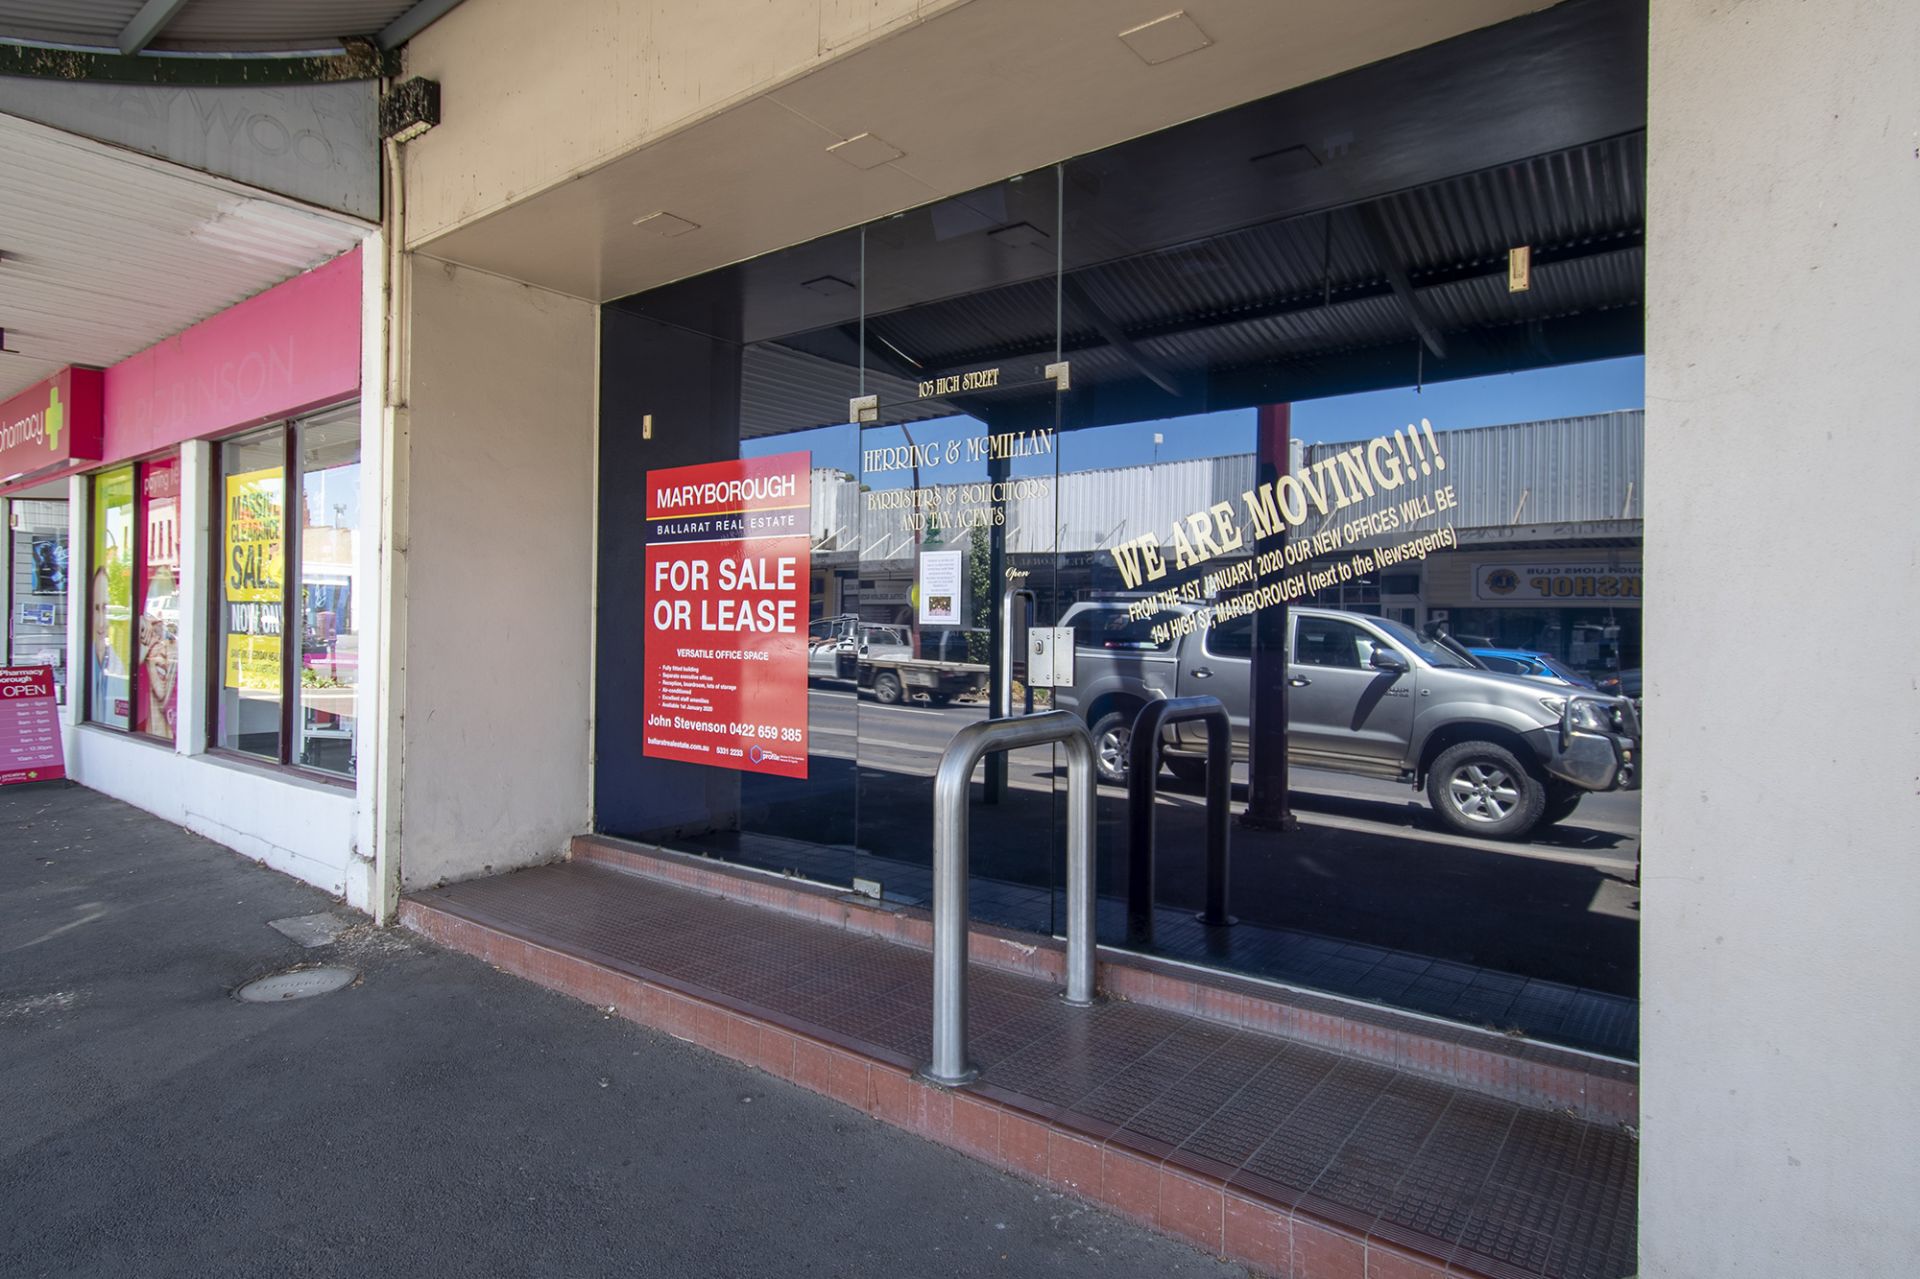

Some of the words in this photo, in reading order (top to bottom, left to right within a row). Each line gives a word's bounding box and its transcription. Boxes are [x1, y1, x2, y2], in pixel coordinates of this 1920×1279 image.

[918, 381, 934, 397] 105
[936, 375, 960, 395] HIGH
[963, 368, 999, 390] STREET
[863, 442, 940, 472] HERRING
[945, 439, 963, 465] &
[656, 474, 796, 509] MARYBOROUGH
[867, 485, 943, 511] BARRISTERS
[946, 485, 957, 505] &
[962, 475, 1049, 504] SOLICITORS
[1110, 532, 1167, 590] WE
[1174, 501, 1243, 571] ARE
[1242, 417, 1446, 541] MOVING!!!
[656, 521, 711, 535] BALLARAT
[715, 519, 745, 532] REAL
[750, 515, 795, 528] ESTATE
[902, 512, 926, 532] AND
[929, 509, 951, 530] TAX
[957, 506, 1005, 529] AGENTS
[1128, 600, 1160, 622] FROM
[1158, 588, 1182, 613] THE
[1181, 579, 1201, 603] 1ST
[1203, 558, 1259, 599] JANUARY,
[1257, 548, 1284, 577] 2020
[1285, 540, 1318, 565] OUR
[1313, 530, 1342, 556] NEW
[1344, 508, 1400, 543] OFFICES
[1399, 496, 1435, 524] WILL
[1434, 485, 1458, 512] BE
[655, 560, 709, 592] FOR
[718, 557, 797, 592] SALE
[1005, 566, 1030, 581] Open
[1150, 624, 1170, 645] 194
[1170, 611, 1199, 637] HIGH
[1199, 606, 1218, 630] ST,
[1216, 573, 1306, 625] MARYBOROUGH
[1308, 563, 1339, 597] (next
[1340, 558, 1352, 581] to
[1352, 554, 1375, 577] the
[1373, 522, 1457, 571] Newsagents)
[231, 603, 260, 634] NOW
[653, 599, 691, 631] OR
[701, 599, 797, 633] LEASE
[676, 648, 714, 659] VERSATILE
[715, 650, 742, 660] OFFICE
[743, 651, 769, 661] SPACE
[3, 684, 46, 697] OPEN
[648, 713, 672, 727] John
[674, 716, 727, 734] Stevenson
[729, 722, 755, 737] 0422
[757, 725, 778, 739] 659
[781, 727, 802, 742] 385
